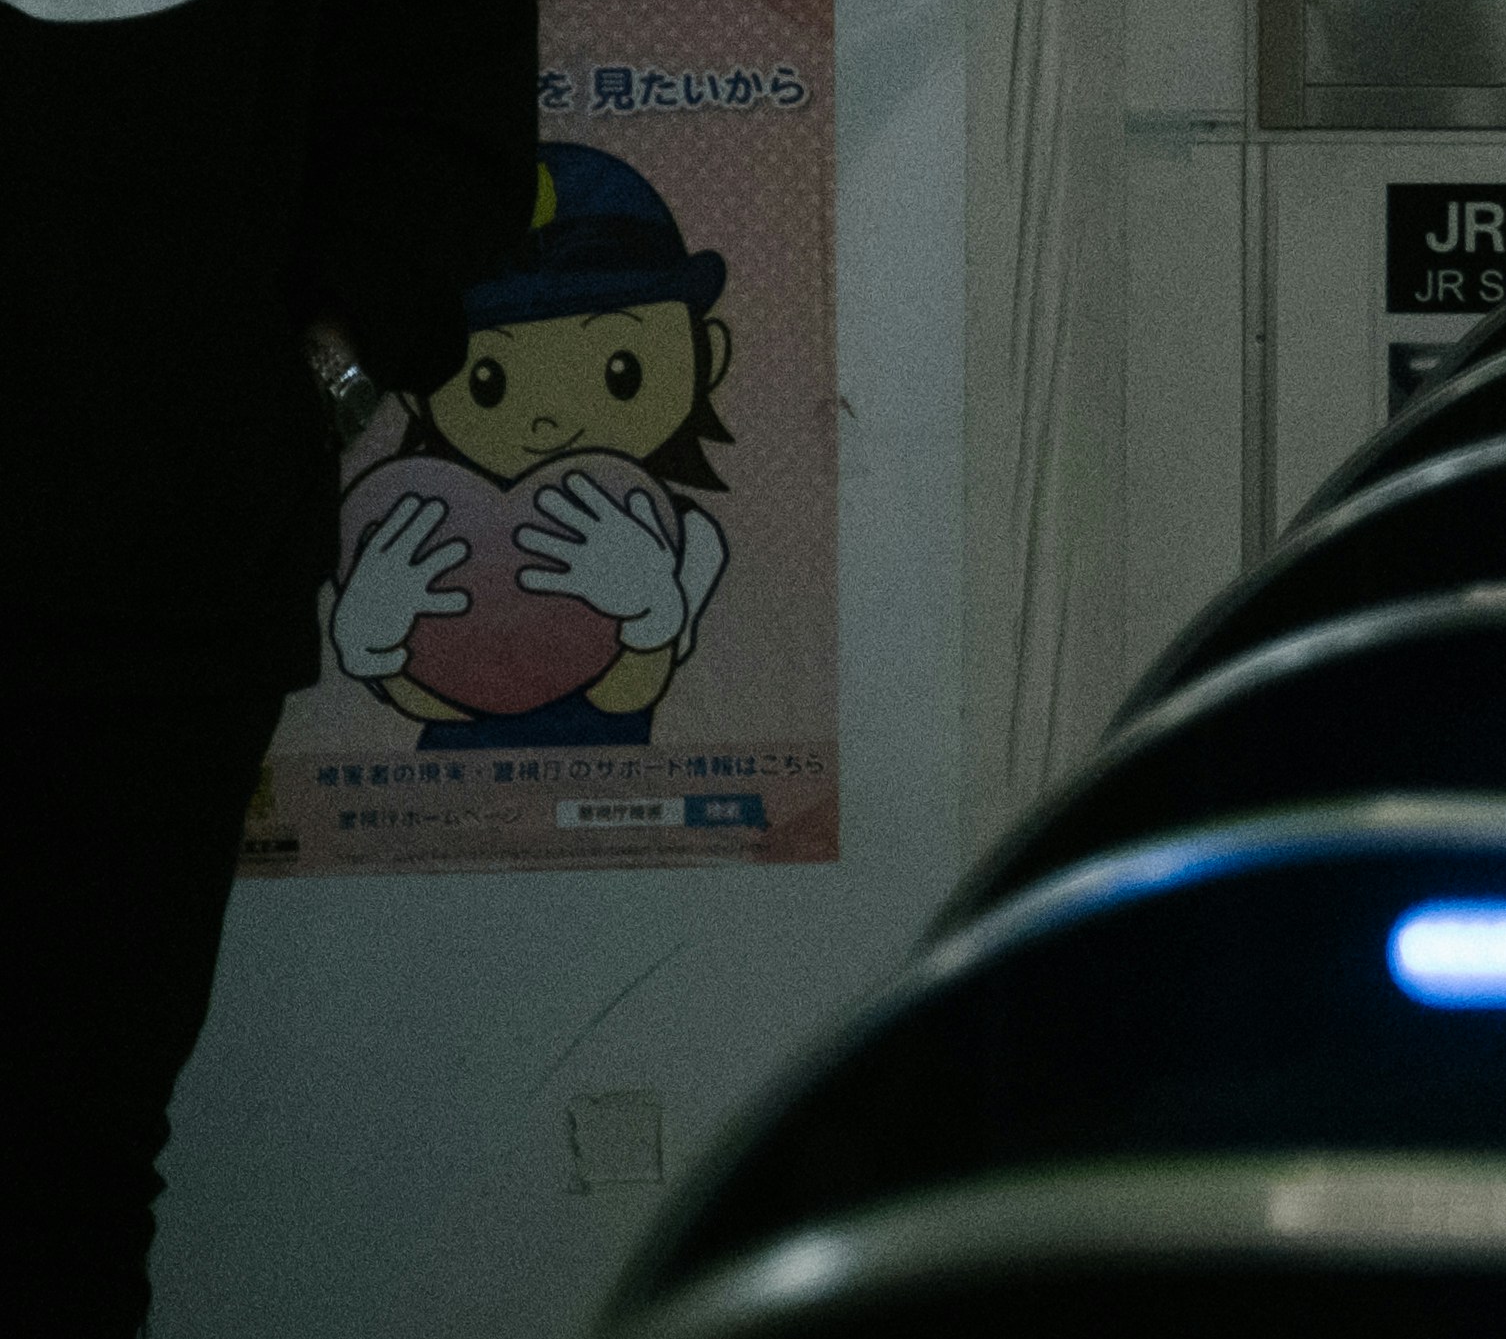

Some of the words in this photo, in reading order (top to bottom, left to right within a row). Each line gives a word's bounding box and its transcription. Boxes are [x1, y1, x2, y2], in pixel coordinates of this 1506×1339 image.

[592, 66, 806, 112] 見たいから
[1425, 200, 1506, 254] JR
[1414, 268, 1466, 303] JR
